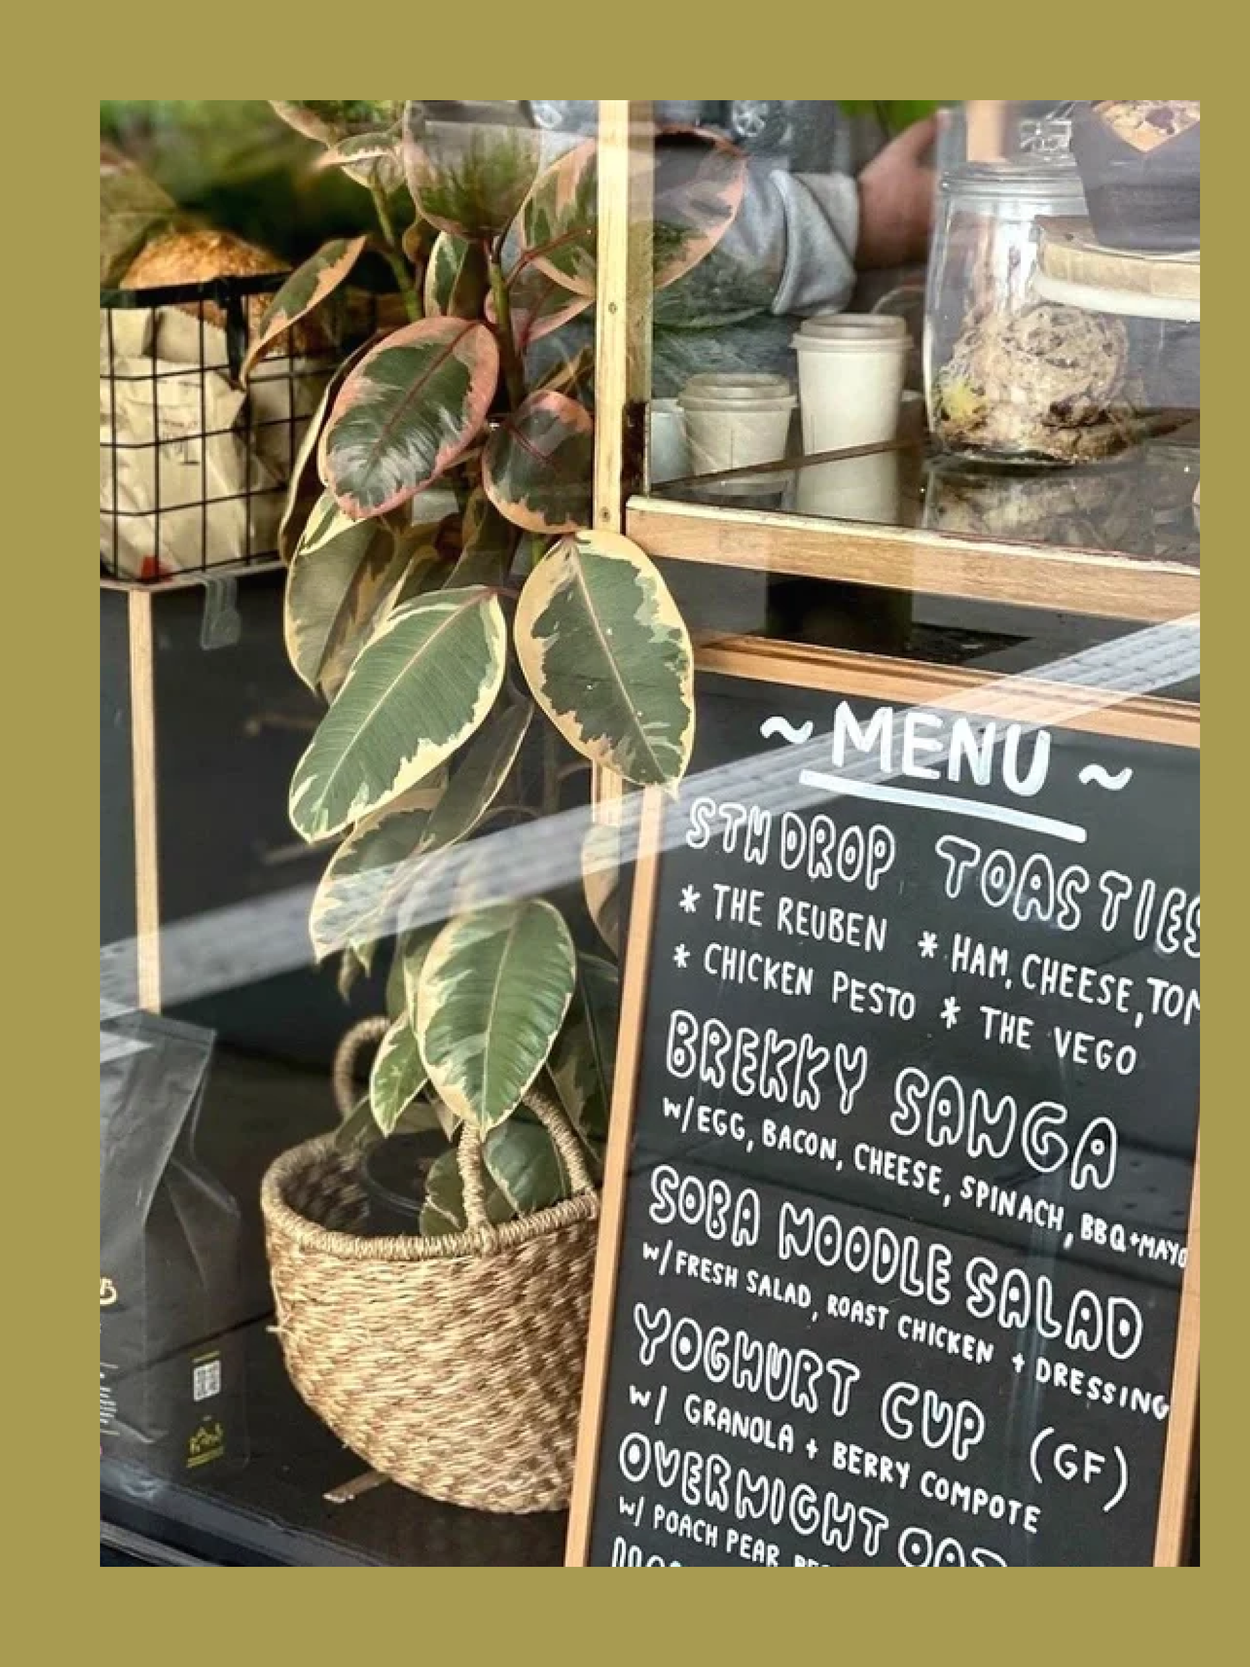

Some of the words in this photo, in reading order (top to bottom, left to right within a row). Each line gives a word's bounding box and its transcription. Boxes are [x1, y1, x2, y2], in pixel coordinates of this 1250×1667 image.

[831, 700, 1052, 798] MENU
[686, 798, 771, 866] STH
[780, 812, 896, 891] DROP
[713, 883, 763, 927] THE
[777, 896, 888, 952] REUBEN
[704, 943, 814, 997] CHICKEN
[832, 976, 916, 1022] PESTO
[952, 933, 1012, 989] HAM,
[1021, 953, 1144, 1028] CHEESE,
[980, 1005, 1034, 1050] THE
[1054, 1026, 1137, 1076] VEGO
[666, 1009, 868, 1114] BREKKY
[890, 1067, 1117, 1190] SANGA
[762, 1118, 843, 1171] BACON,
[854, 1142, 951, 1208] CHEESE,
[960, 1175, 1074, 1249] SPINACH,
[648, 1164, 761, 1248] SOBA
[778, 1205, 952, 1306] NOODLE
[964, 1256, 1143, 1360] SALAD
[633, 1301, 861, 1419] YOGHURT
[881, 1381, 986, 1462] CUP
[745, 1272, 819, 1322] SALAD,
[827, 1293, 889, 1331] ROAST
[898, 1314, 995, 1366] CHICKEN
[1011, 1352, 1024, 1374] +
[1036, 1360, 1170, 1421] DRESSING
[619, 1432, 889, 1556] OVERNIGHT
[628, 1384, 669, 1425] w/
[684, 1393, 795, 1454] GRANOLA
[805, 1438, 819, 1460] +
[832, 1442, 910, 1491] BERRY
[920, 1471, 1042, 1535] COMPOTE
[1030, 1426, 1130, 1513] (GF)
[619, 1496, 646, 1527] w/
[653, 1504, 719, 1548] POACH
[726, 1528, 780, 1567] PEAR
